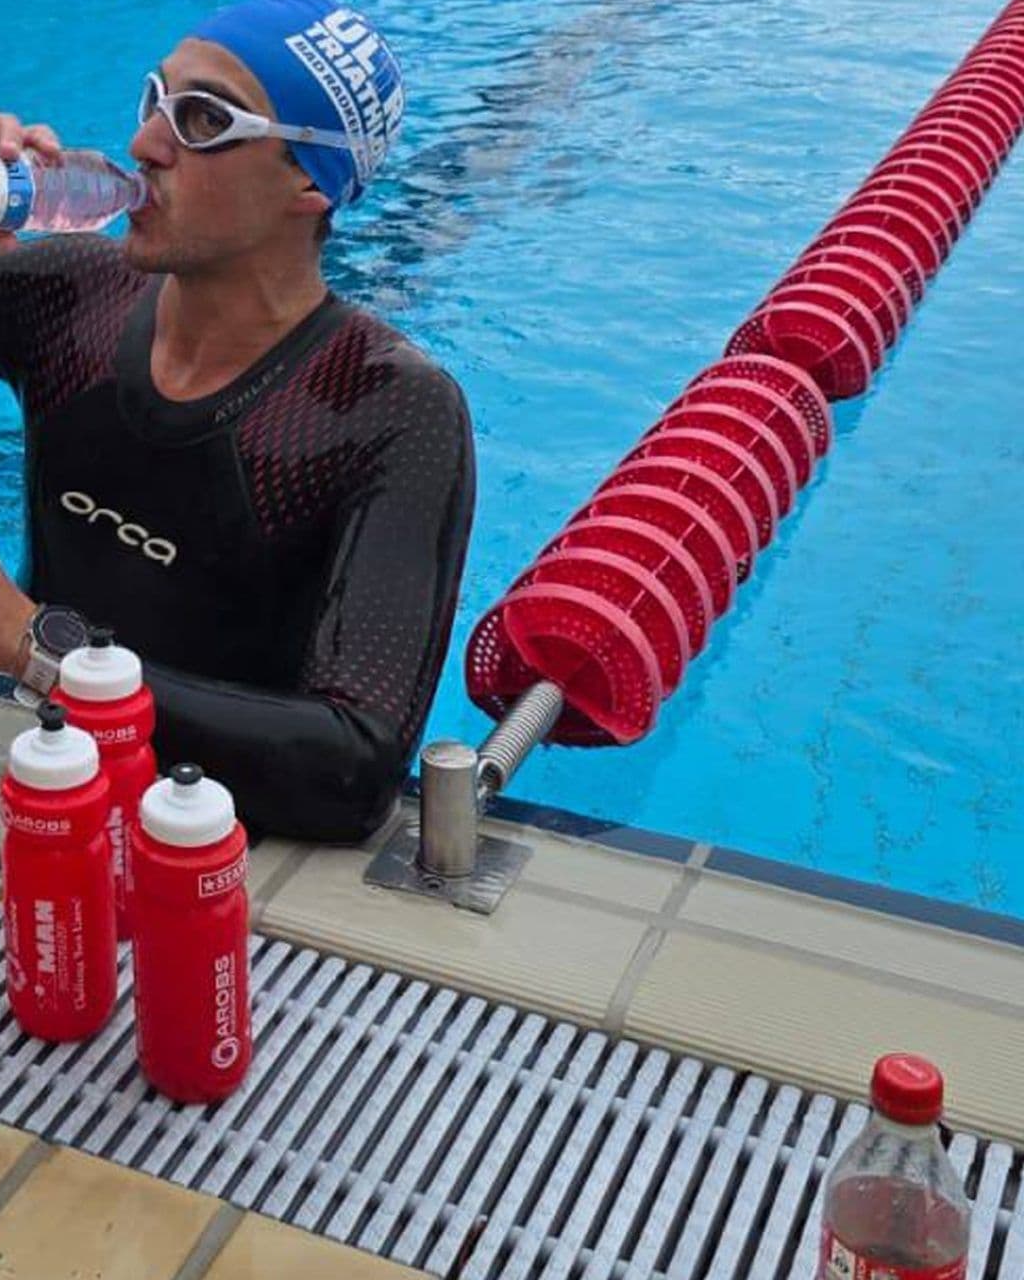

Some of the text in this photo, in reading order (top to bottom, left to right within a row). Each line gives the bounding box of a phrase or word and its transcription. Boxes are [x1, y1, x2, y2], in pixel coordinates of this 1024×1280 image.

[294, 40, 324, 75] BAD
[323, 8, 404, 140] ULR
[59, 490, 177, 567] orca
[93, 724, 138, 741] ROBS
[215, 954, 231, 1038] AROBS
